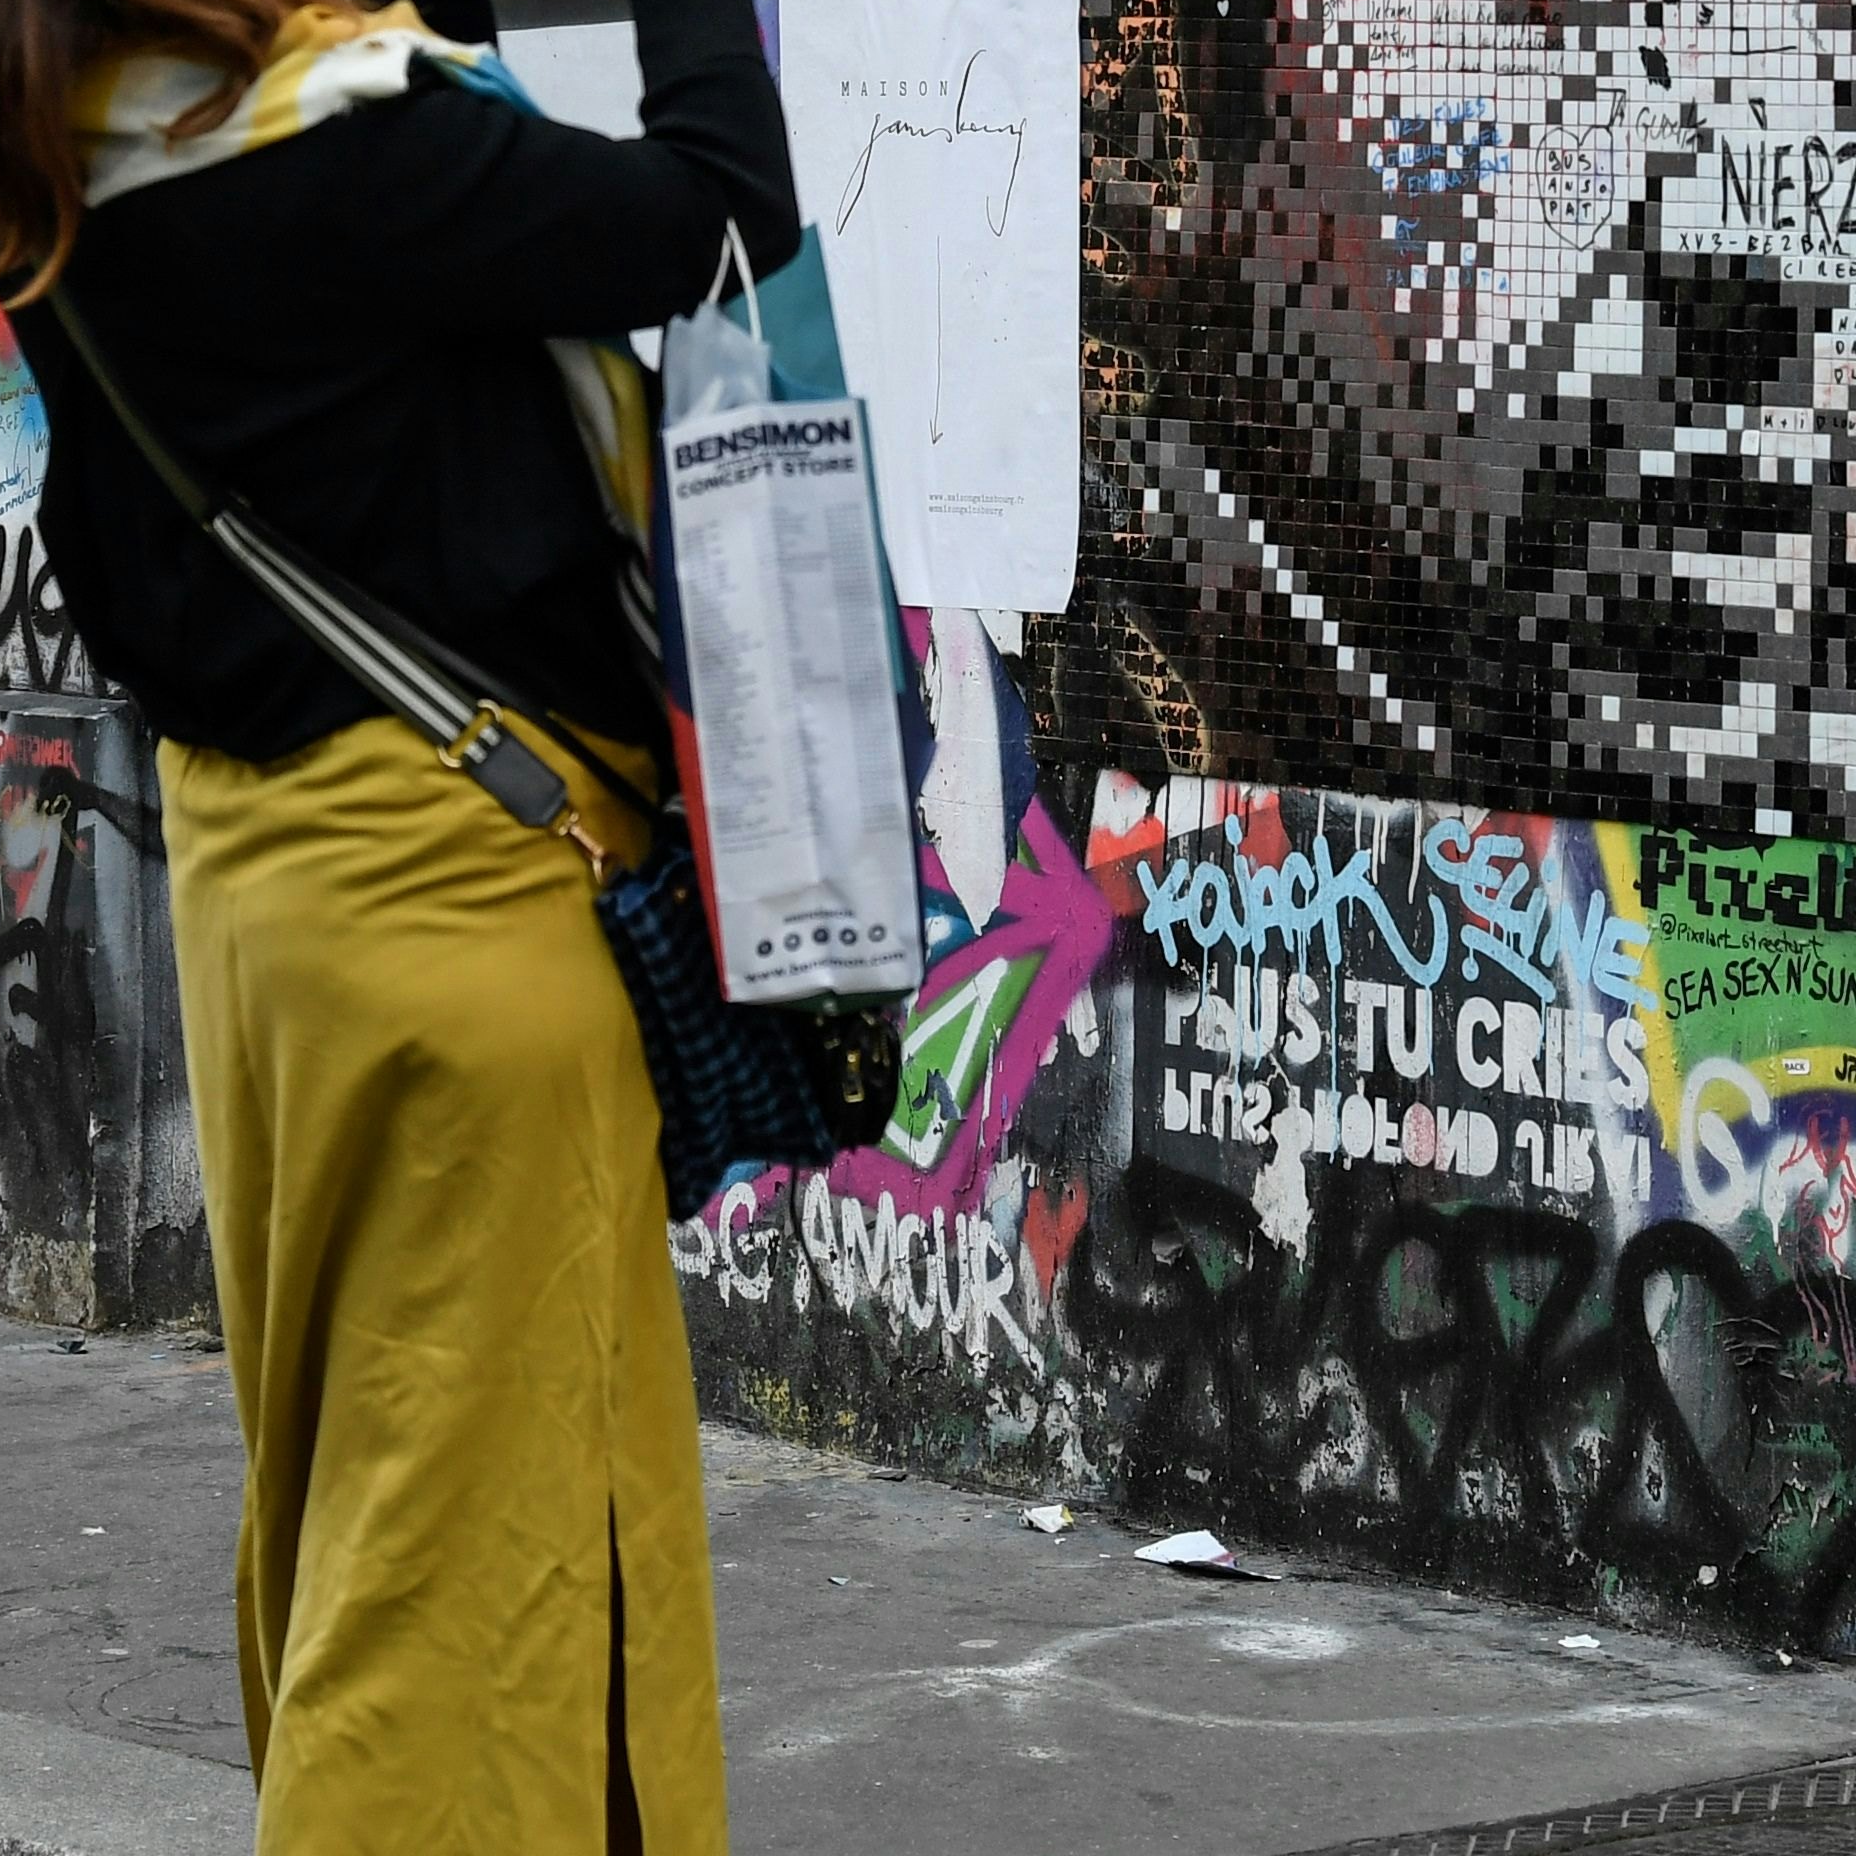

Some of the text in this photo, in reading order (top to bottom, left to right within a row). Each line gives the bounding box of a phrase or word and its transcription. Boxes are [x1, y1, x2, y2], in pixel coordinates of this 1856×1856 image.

[839, 78, 950, 99] MAISON
[1547, 200, 1594, 219] PAT
[675, 417, 853, 471] BENSIMON
[676, 455, 858, 501] CONCEPT STORE
[1664, 967, 1718, 1021] SEA
[1722, 954, 1781, 1002] SEX
[1162, 977, 1653, 1112] PLUS TU CRIES
